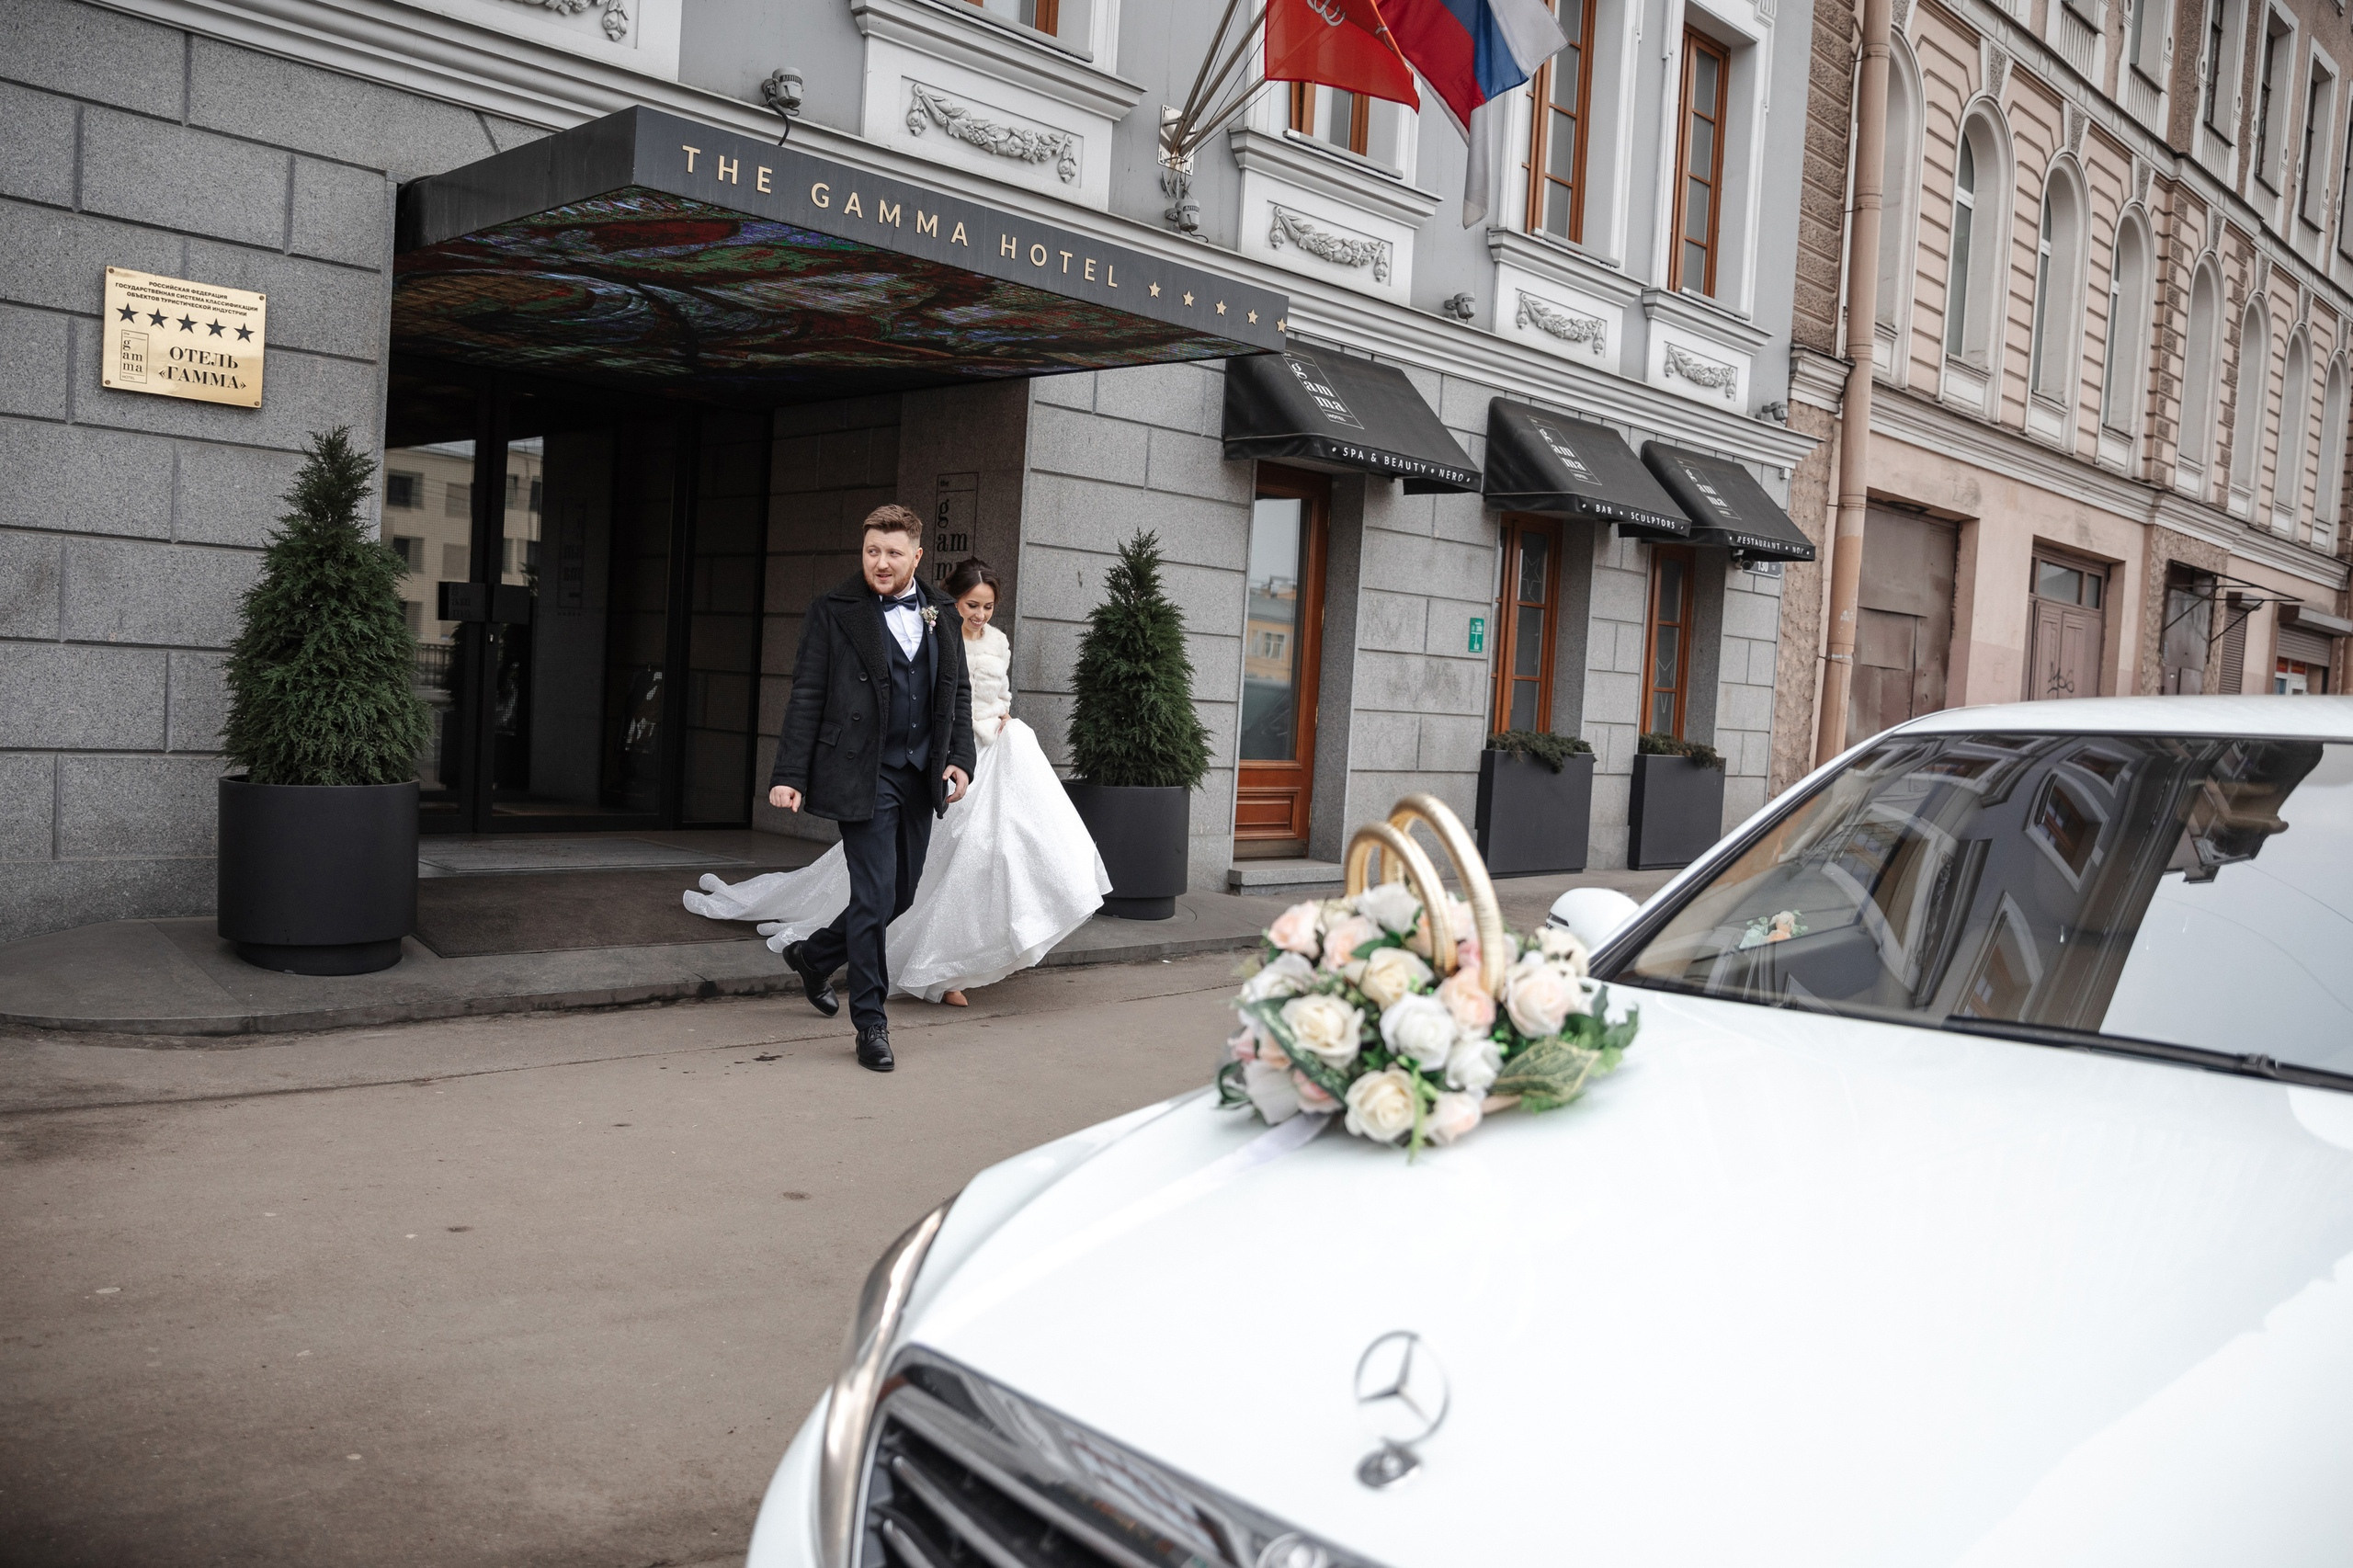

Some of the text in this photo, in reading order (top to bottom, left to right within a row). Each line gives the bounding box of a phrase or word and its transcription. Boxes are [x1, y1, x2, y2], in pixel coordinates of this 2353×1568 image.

[682, 144, 1118, 289] THE GAMMA HOTEL
[115, 282, 258, 312] ГОСУДАРСТВЕННАЯ СИСТЕМА КЛАССИФИКАЦИИ
[148, 280, 228, 300] РОССИЙСКАЯ ФЕДЕРАЦИЯ
[126, 291, 247, 317] ОБЪЕКТОВ ТУРИСТИЧЕСКОЙ ИНДУСТРИИ
[169, 346, 239, 369] ОТЕЛЬ
[158, 365, 247, 390] «ГАММА»
[1342, 447, 1464, 483] SPA & BEAUTY NERO
[937, 498, 949, 528] g
[1595, 504, 1676, 529] BAR SCULPTORS
[936, 531, 968, 552] am
[1736, 536, 1780, 551] RESTAURANT
